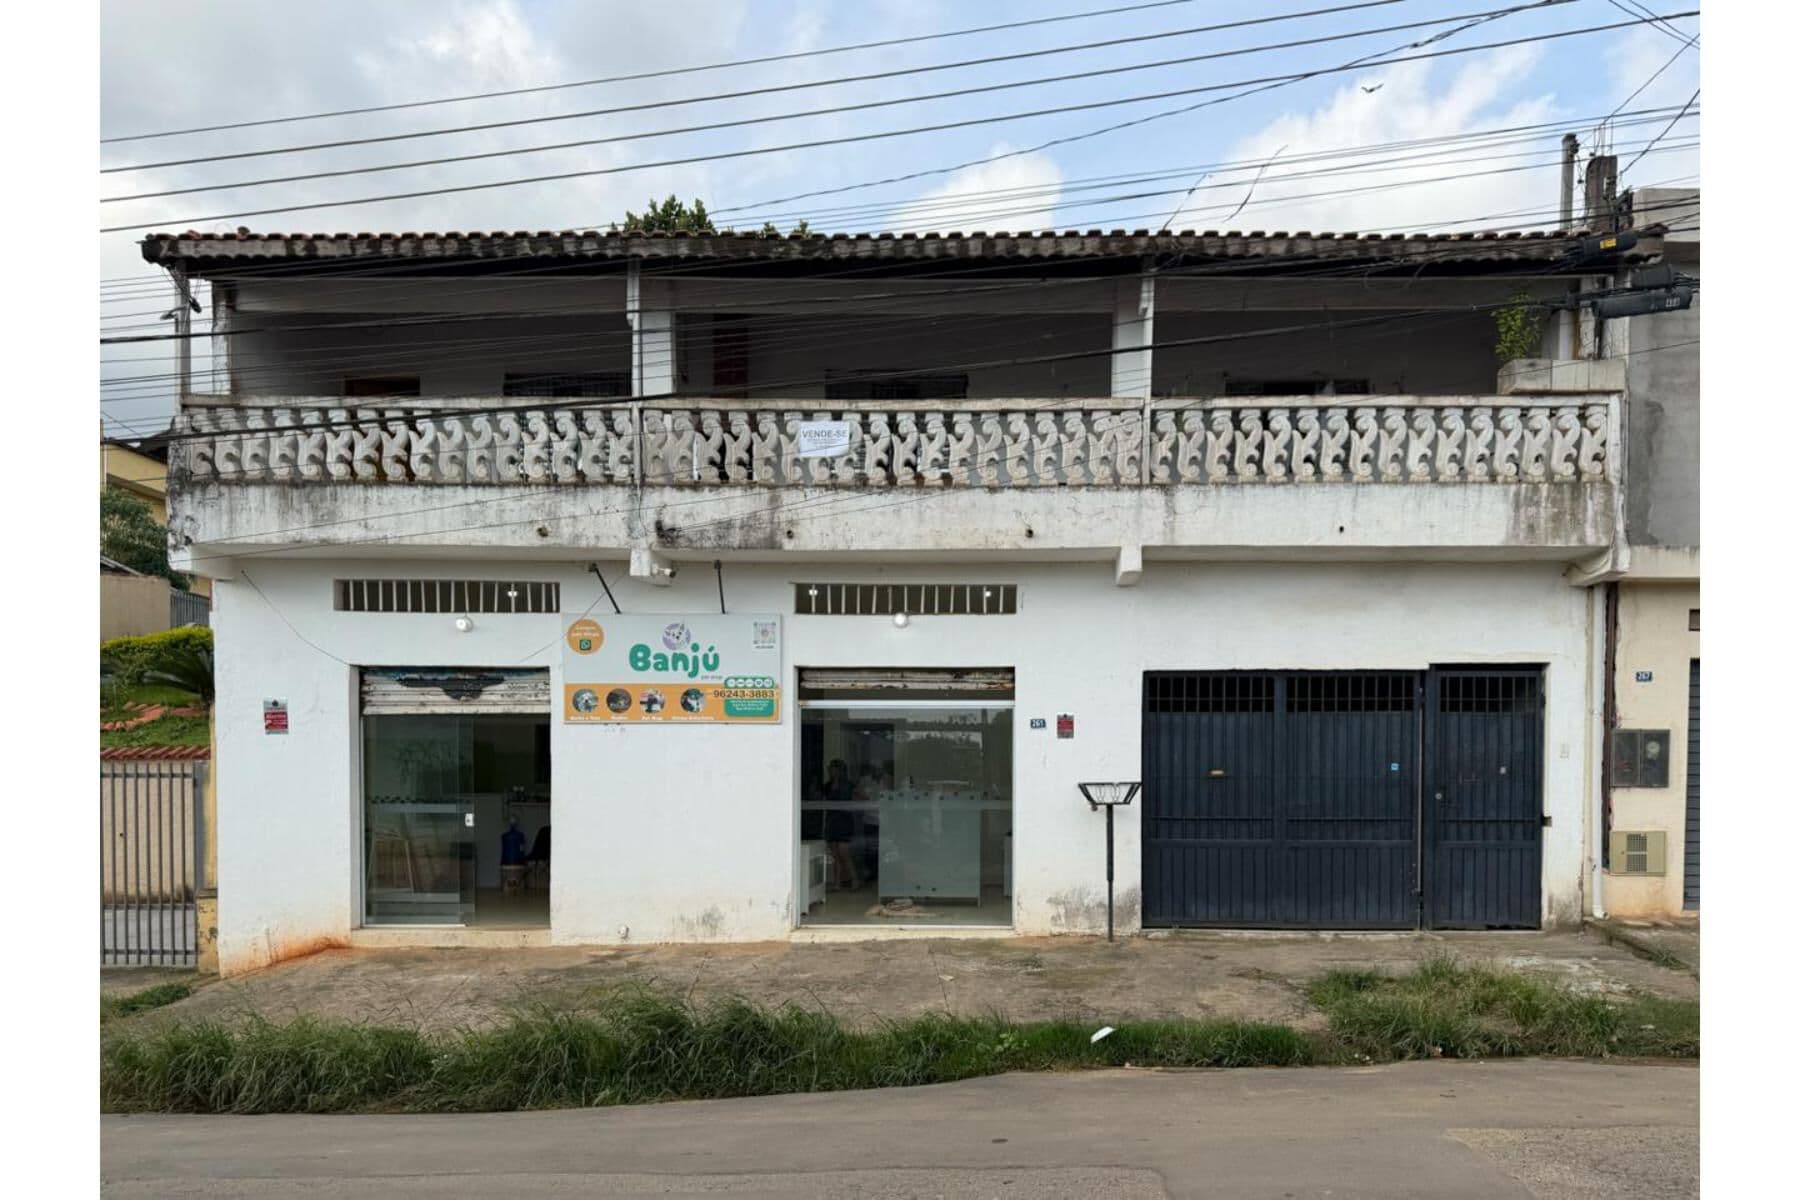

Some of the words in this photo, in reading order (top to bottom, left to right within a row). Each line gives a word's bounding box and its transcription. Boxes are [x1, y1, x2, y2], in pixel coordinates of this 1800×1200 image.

[802, 430, 848, 439] VENDE-SE
[629, 642, 720, 679] Banjú
[713, 689, 775, 698] 96243-3883
